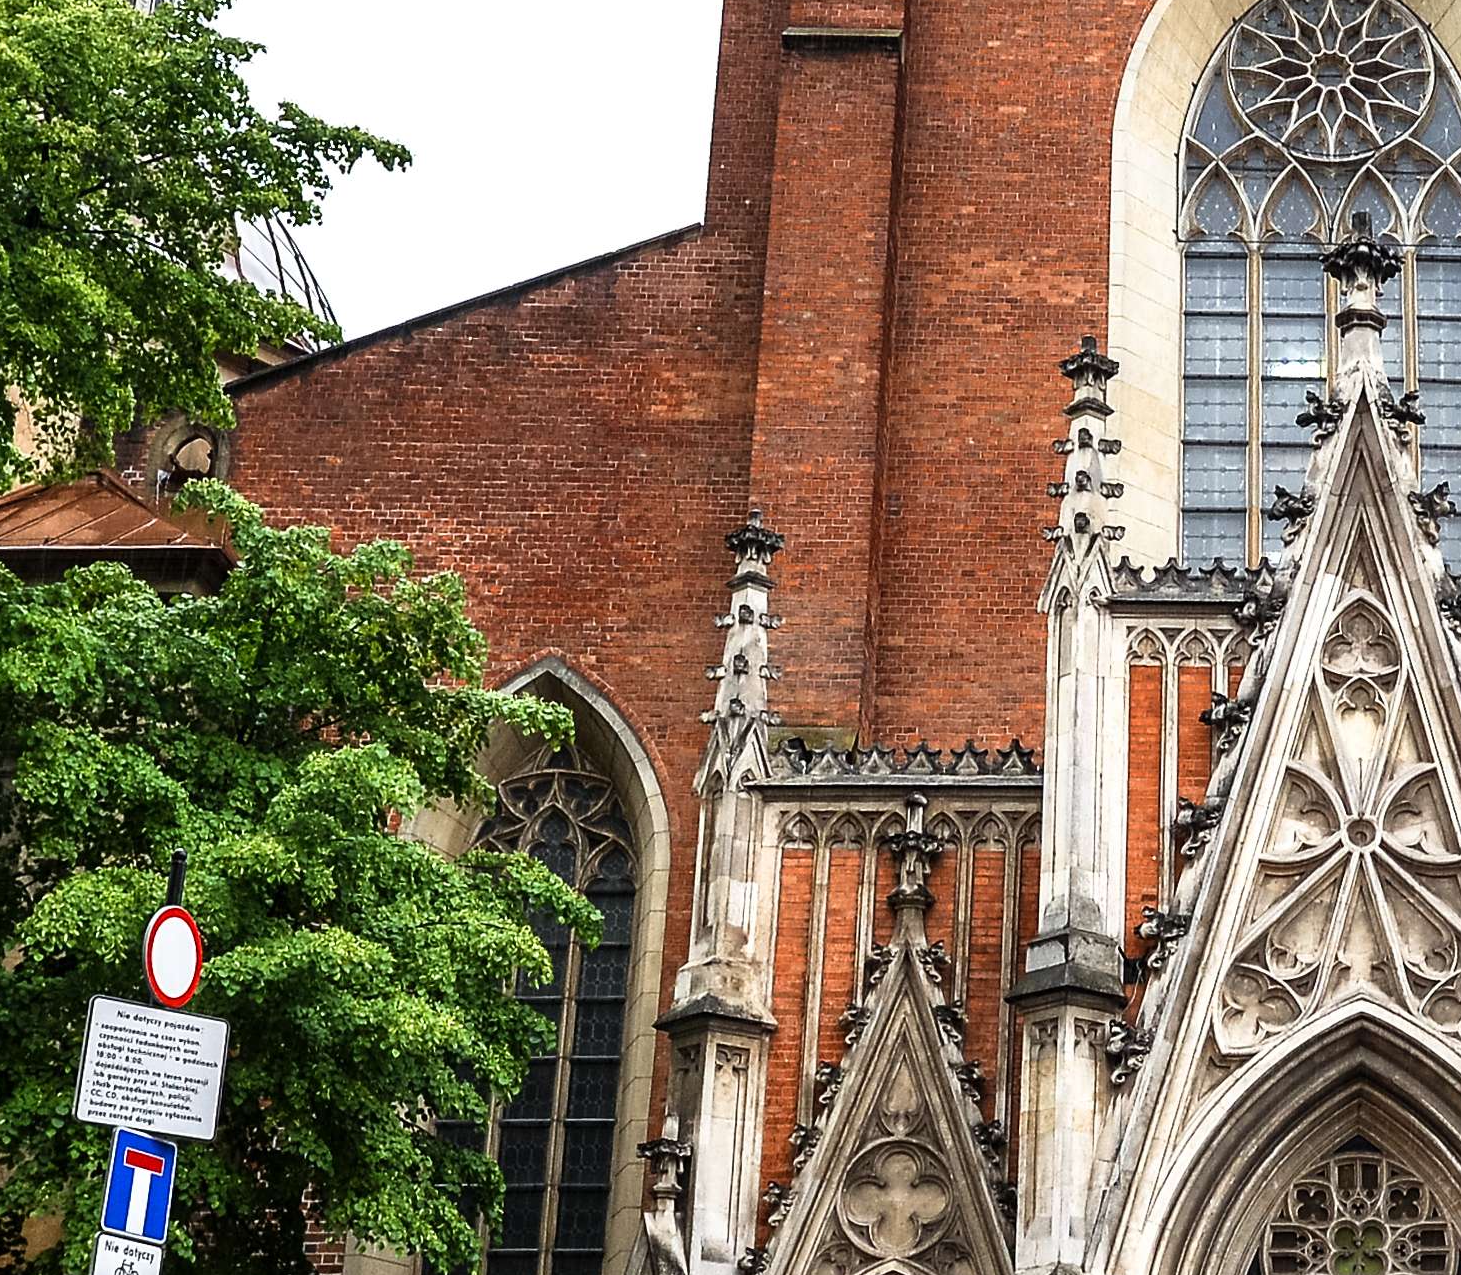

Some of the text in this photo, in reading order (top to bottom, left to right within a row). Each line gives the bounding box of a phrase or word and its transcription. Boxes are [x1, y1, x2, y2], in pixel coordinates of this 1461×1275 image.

[117, 1010, 130, 1020] Nie
[133, 1013, 161, 1027] dotyczy
[105, 1240, 154, 1264] Nie dotyczy
